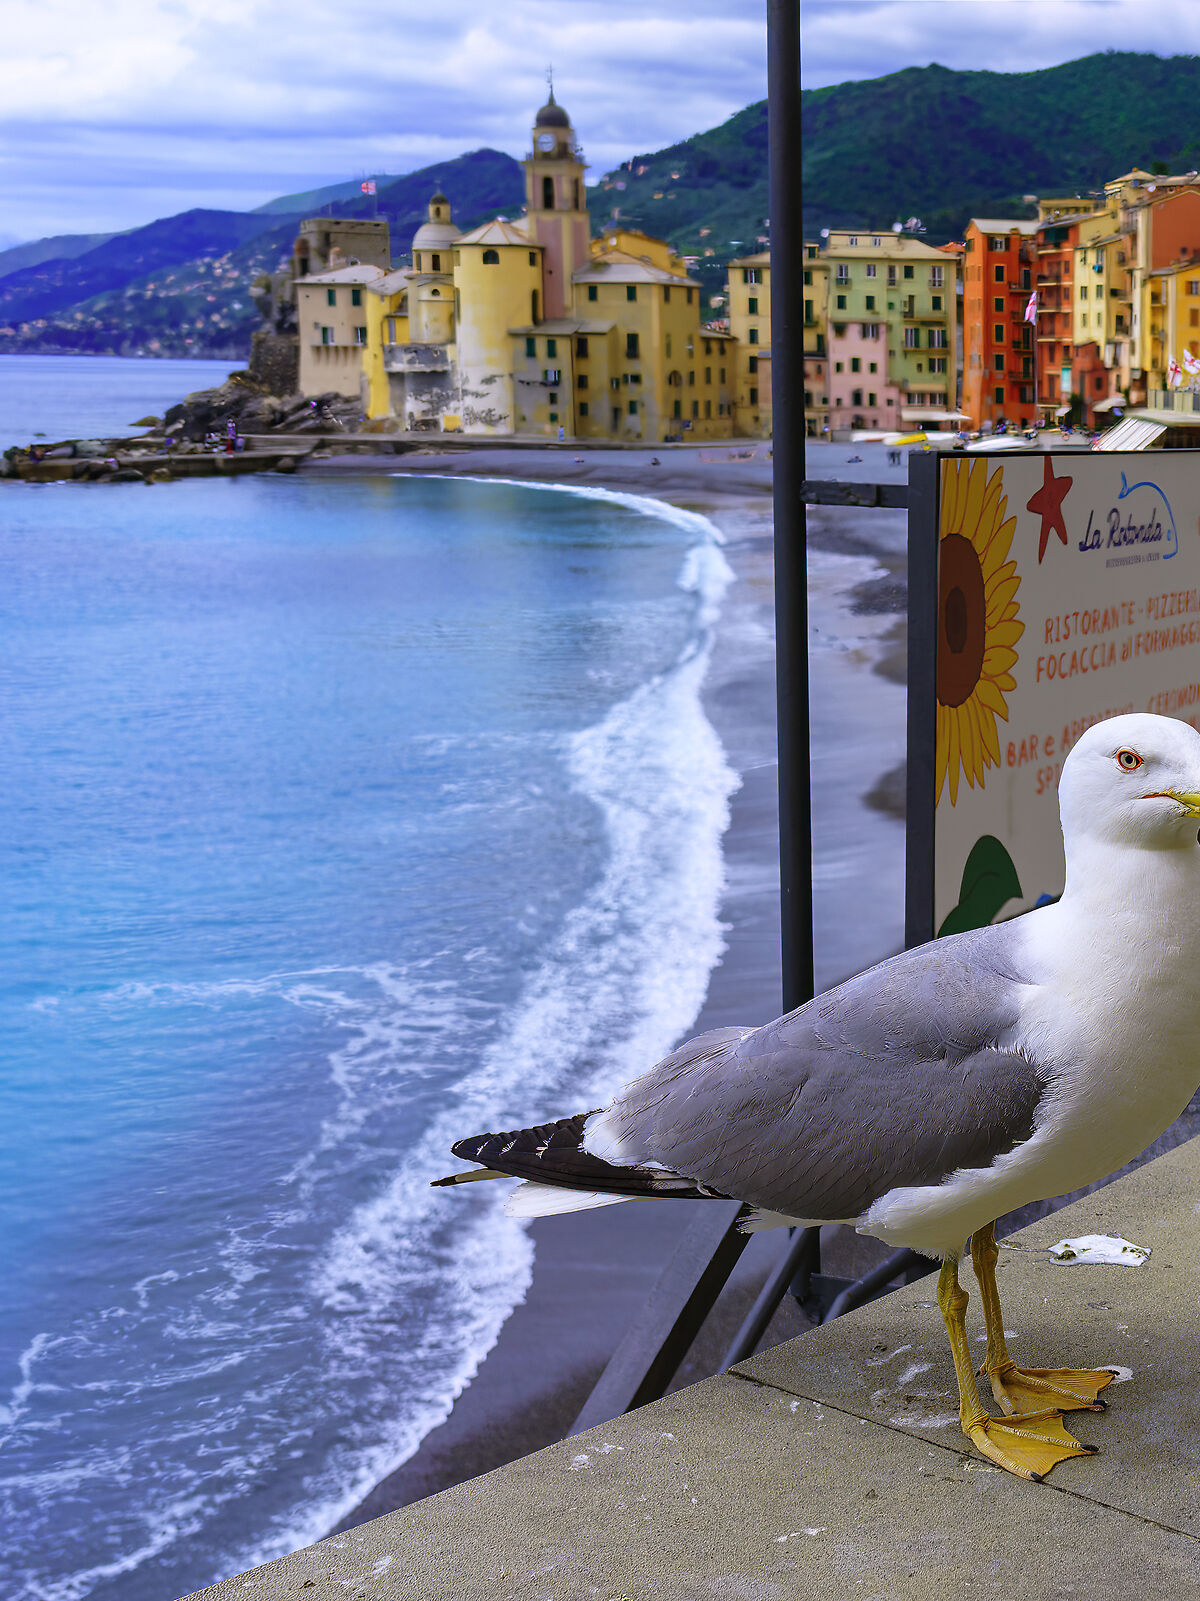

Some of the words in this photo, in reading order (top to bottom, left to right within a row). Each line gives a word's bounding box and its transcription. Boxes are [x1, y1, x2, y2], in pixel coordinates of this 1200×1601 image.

[1079, 509, 1104, 552] La
[1106, 507, 1164, 549] Rotonda
[1044, 601, 1135, 644] RISTORANTE
[1036, 641, 1117, 683] FOCACCIA
[1006, 734, 1038, 768] BAR
[1043, 735, 1055, 757] e
